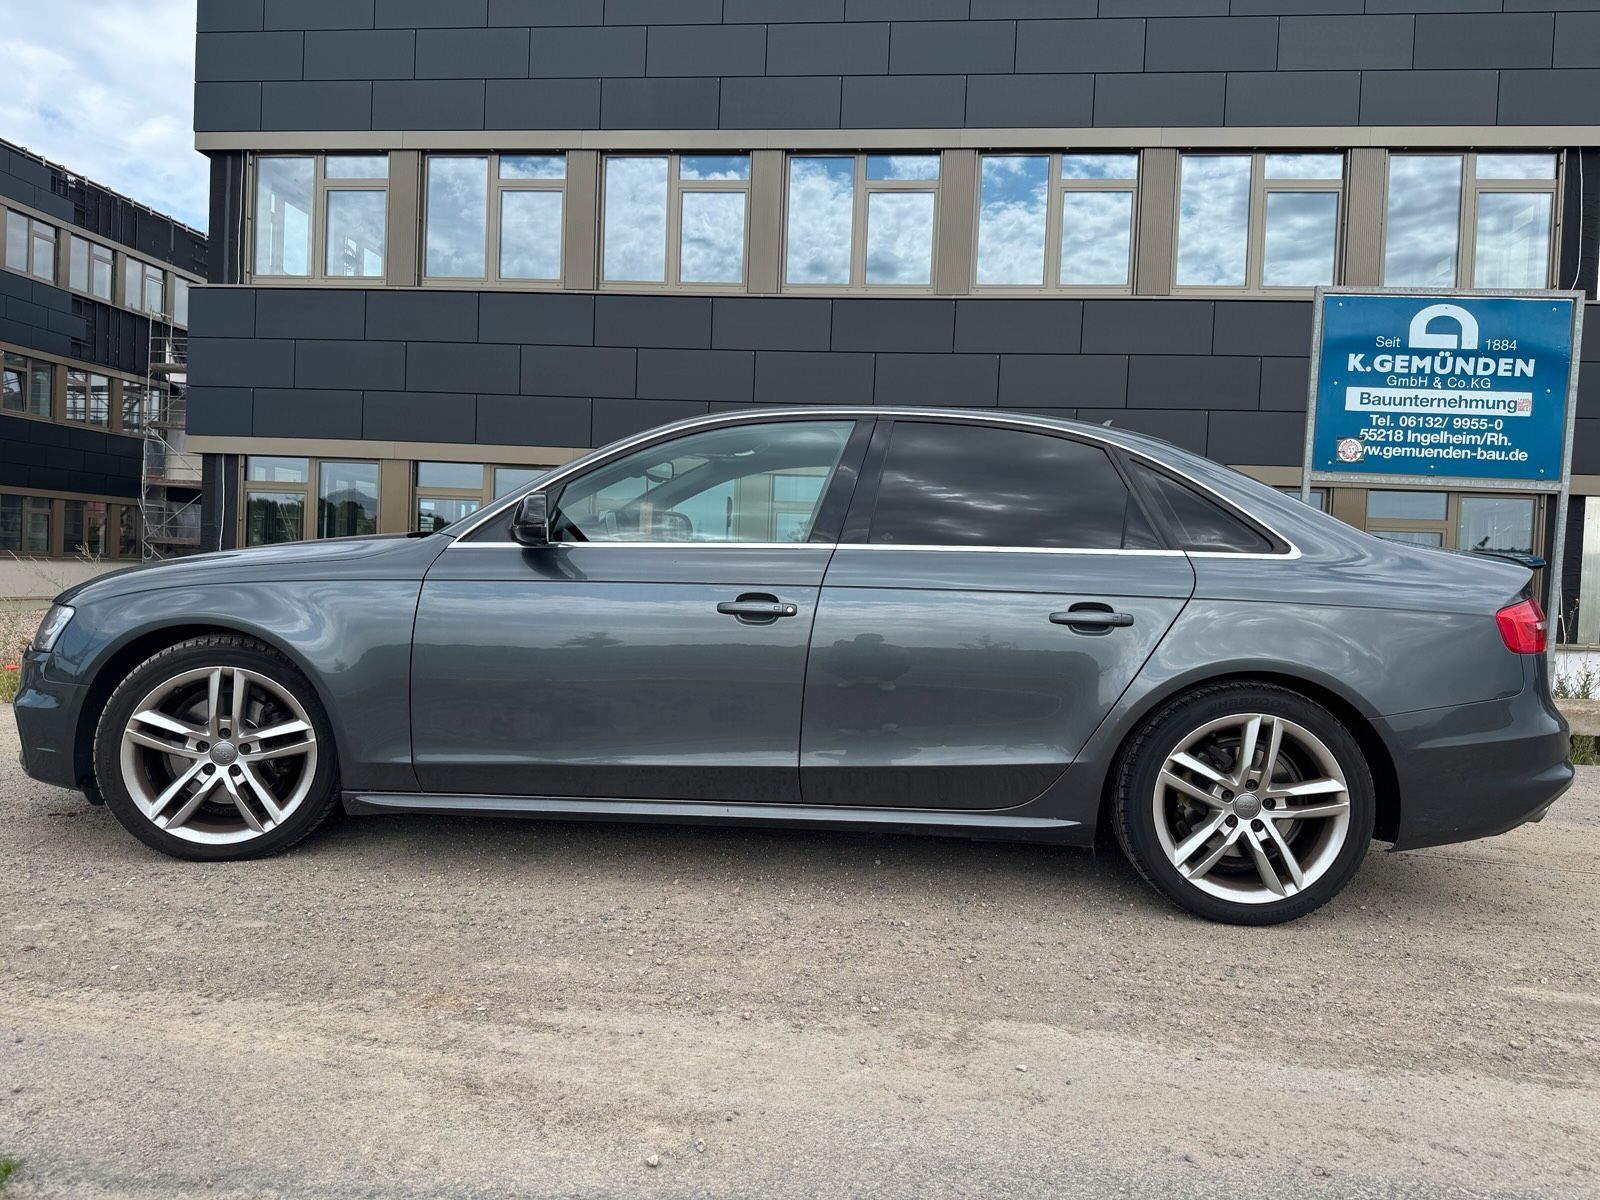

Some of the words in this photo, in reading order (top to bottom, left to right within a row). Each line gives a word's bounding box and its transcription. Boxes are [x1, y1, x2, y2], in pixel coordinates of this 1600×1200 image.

[1375, 336, 1401, 348] Seit
[1485, 338, 1517, 351] 1884
[1347, 351, 1535, 377] K.GEMÜNDEN
[1386, 375, 1428, 387] GmbH
[1432, 376, 1442, 389] &
[1447, 377, 1491, 389] Co.KG
[1359, 392, 1518, 413] Bauunternehmung
[1369, 415, 1395, 427] Tel.
[1399, 415, 1449, 429] 06132/
[1452, 417, 1504, 431] 9955-0
[1360, 428, 1404, 442] 55218
[1407, 429, 1512, 446] Ingelheim/Rh.
